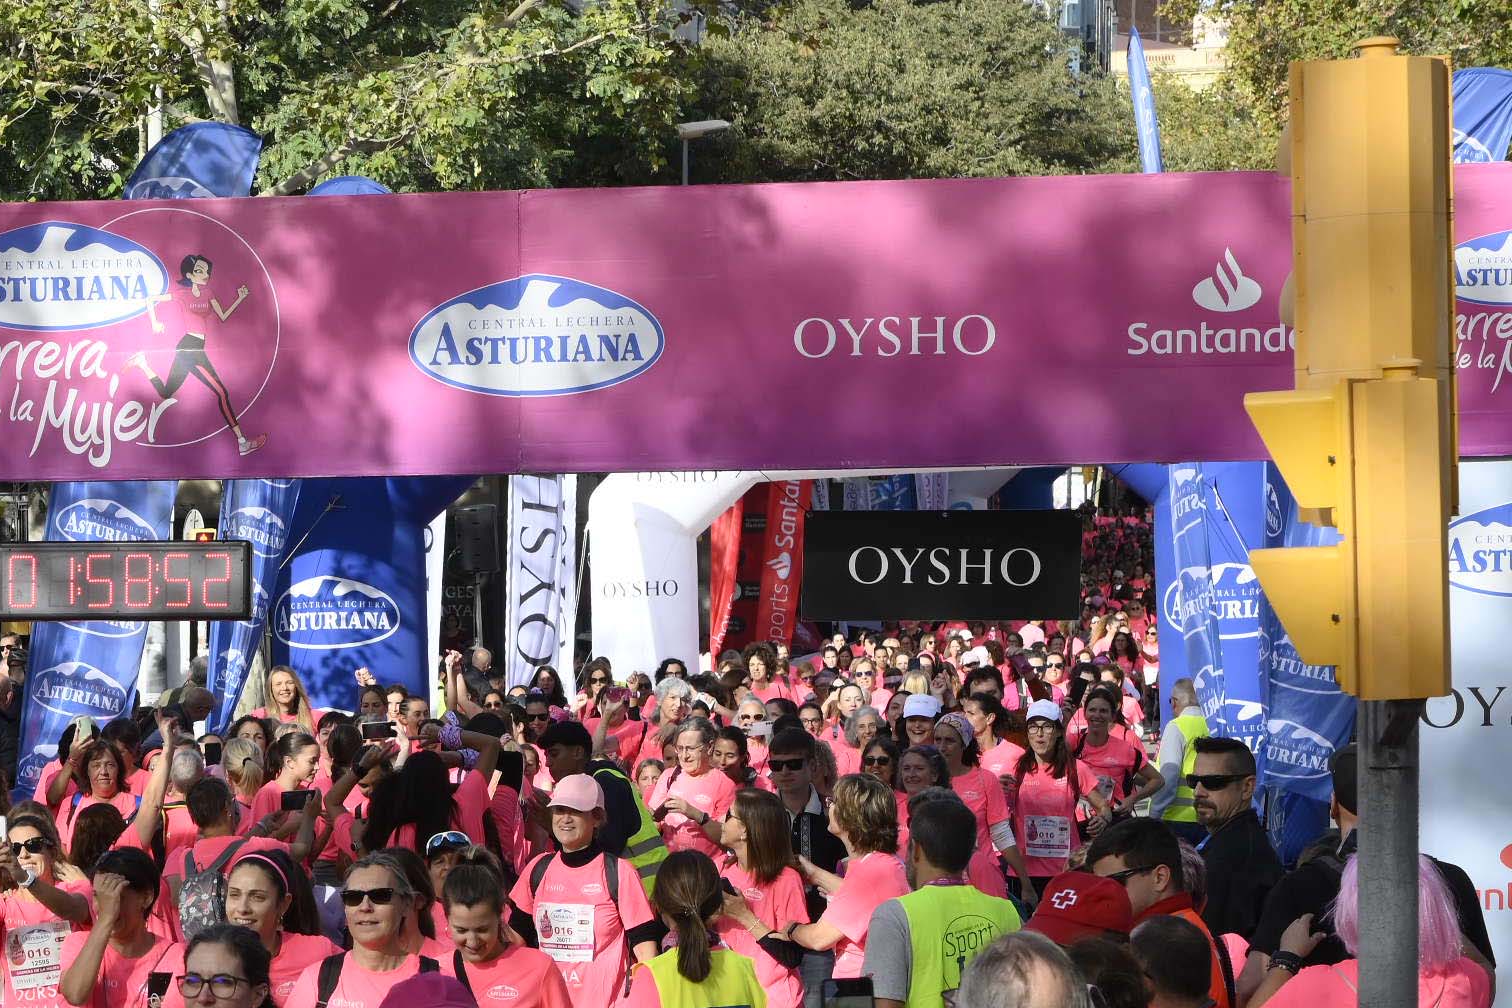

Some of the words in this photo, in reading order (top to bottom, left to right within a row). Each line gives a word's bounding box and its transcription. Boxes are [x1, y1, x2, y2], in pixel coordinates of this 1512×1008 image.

[71, 257, 143, 270] LECHERA
[468, 317, 546, 331] CENTRAL
[555, 314, 637, 328] LECHERA
[428, 321, 645, 367] ASTURIANA
[793, 315, 996, 359] OYSHO
[1477, 341, 1495, 369] la
[9, 382, 35, 422] la
[28, 373, 178, 468] Mujer
[847, 546, 1042, 588] OYSHO
[602, 578, 679, 599] OYSHO
[278, 606, 392, 632] ASTURIANA
[36, 677, 120, 713] ASTURIANA
[554, 926, 573, 936] 016
[945, 922, 994, 957] Sport
[27, 947, 51, 959] 016
